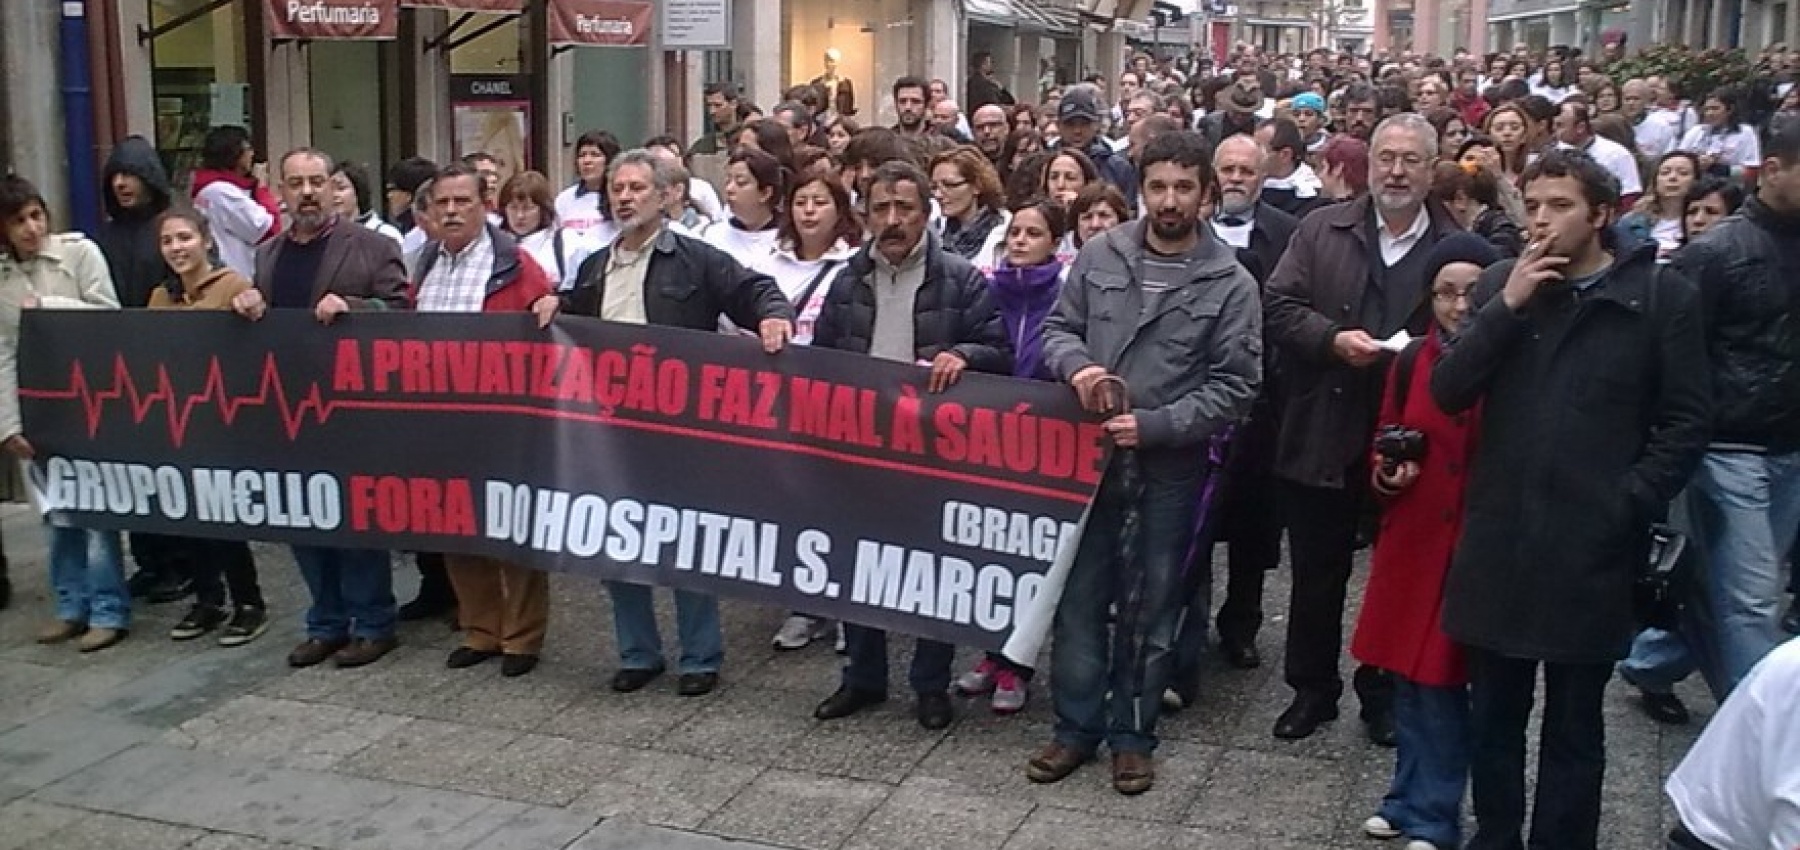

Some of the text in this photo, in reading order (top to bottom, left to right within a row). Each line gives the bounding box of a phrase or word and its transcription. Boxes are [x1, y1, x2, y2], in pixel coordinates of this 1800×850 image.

[286, 0, 379, 24] Perfumaria
[576, 13, 633, 35] Perfumaria
[470, 80, 513, 94] CHANEL
[333, 338, 1106, 484] A PRIVATIZAÇÃO FAZ MAL À SAÚDE
[46, 455, 188, 520] GRUPO
[350, 475, 477, 537] FORA
[485, 479, 531, 546] DO
[531, 488, 783, 587] HOSPITAL
[793, 528, 842, 598] S.
